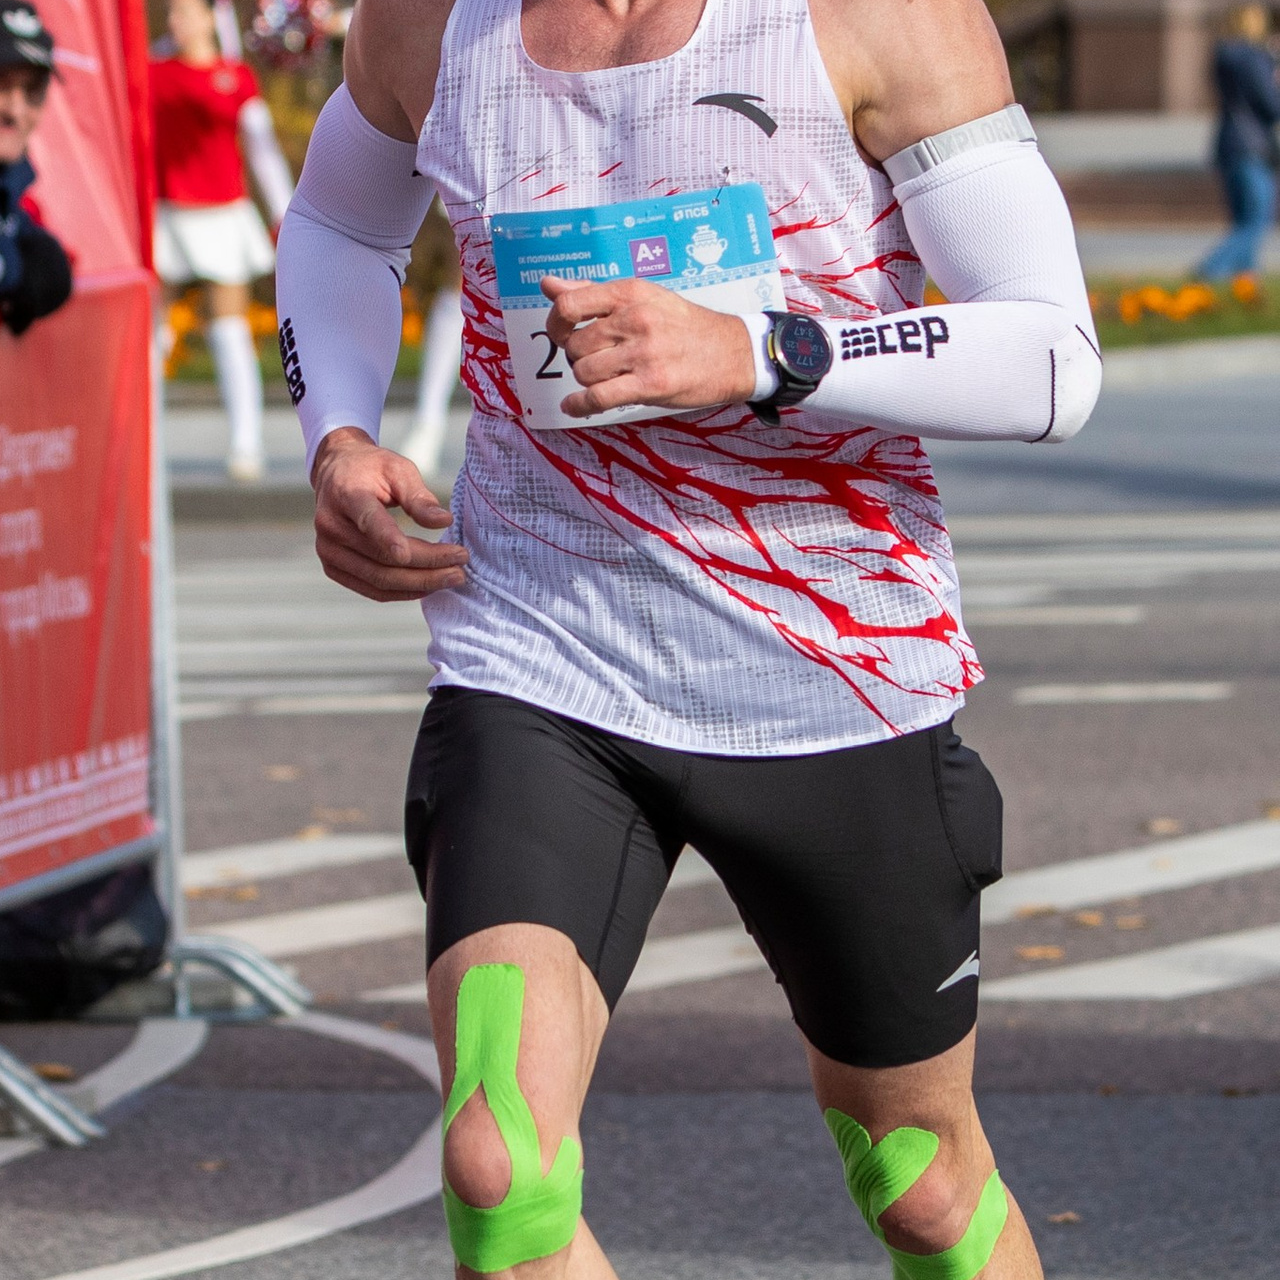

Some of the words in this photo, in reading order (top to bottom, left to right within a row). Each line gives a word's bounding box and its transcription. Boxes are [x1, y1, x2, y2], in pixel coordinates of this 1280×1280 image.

[685, 205, 710, 220] ПСБ
[527, 251, 592, 264] ПОЛУМАРАФОН
[637, 263, 666, 273] КЛАСТЕР
[875, 316, 950, 359] cep
[530, 330, 563, 380] 2
